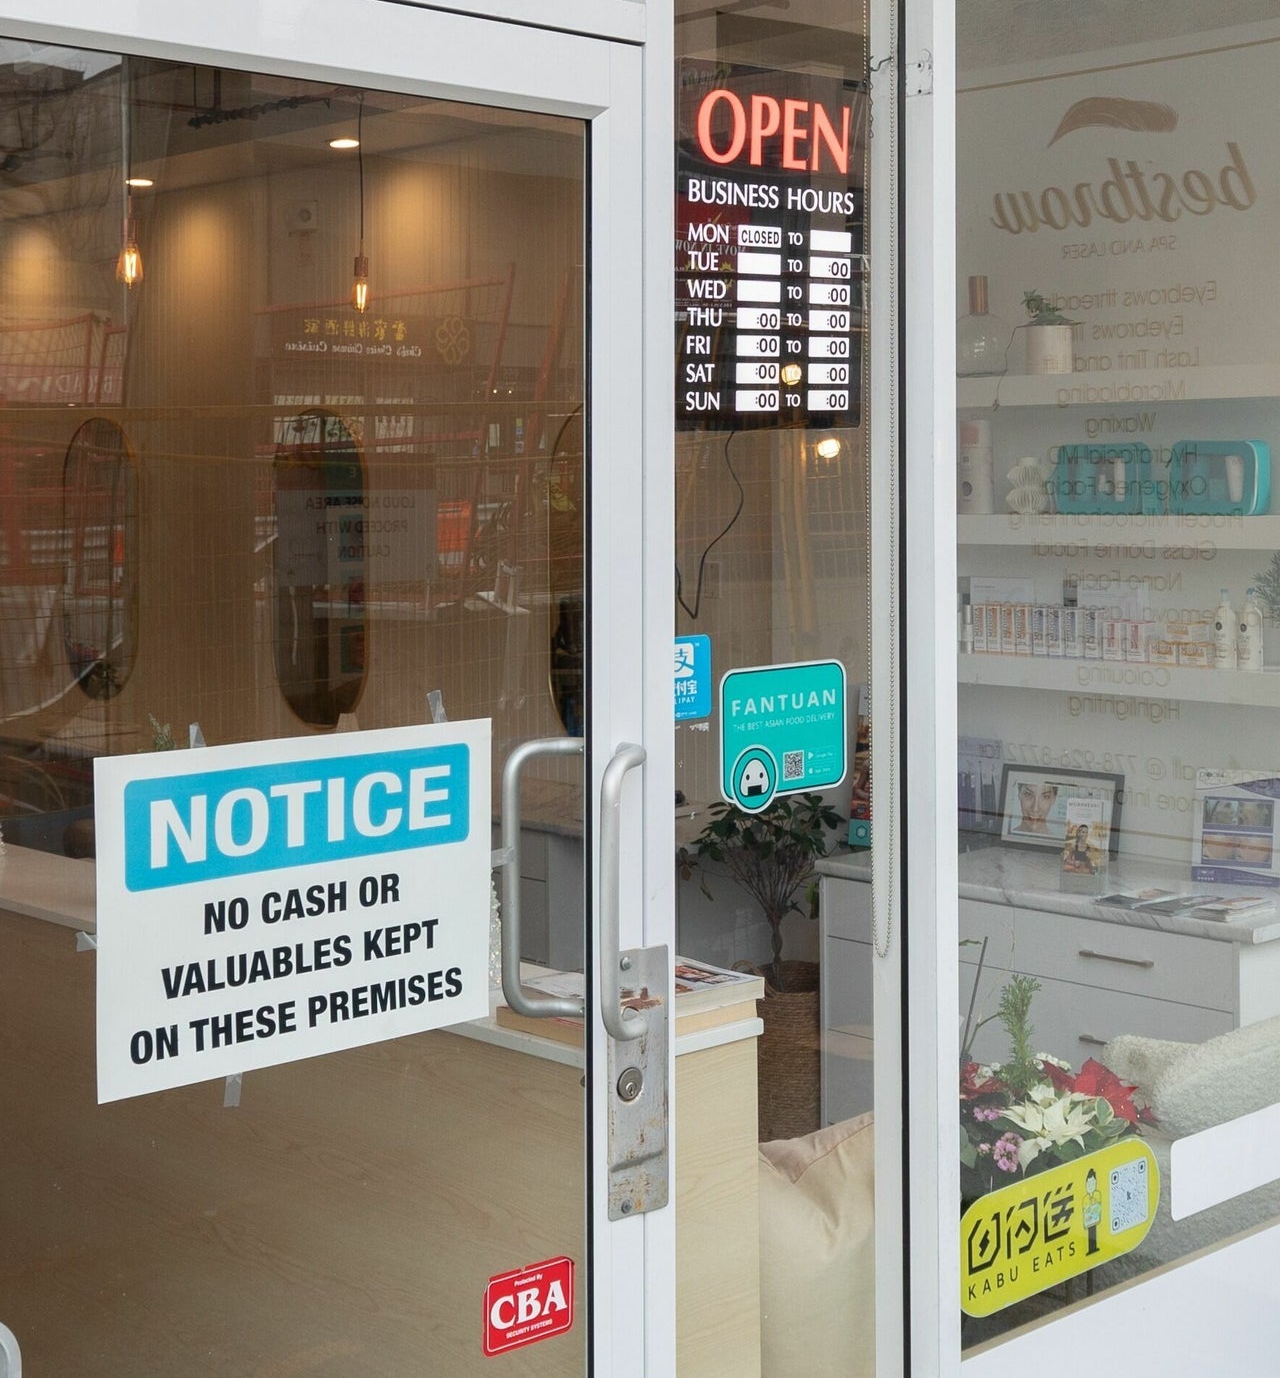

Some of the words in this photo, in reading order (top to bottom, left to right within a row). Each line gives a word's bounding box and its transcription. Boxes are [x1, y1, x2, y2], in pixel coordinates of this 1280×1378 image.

[696, 88, 851, 175] OPEN
[687, 178, 779, 209] BUSINESS
[787, 187, 855, 215] HOURS
[687, 222, 730, 245] MON
[741, 229, 780, 244] CLOSED
[788, 231, 804, 246] TO
[687, 251, 719, 271] TUE
[787, 259, 803, 273] TO
[687, 279, 726, 299] WED
[787, 286, 802, 300] TO
[686, 307, 722, 327] THU
[786, 313, 802, 327] TO
[686, 335, 711, 355] FRI
[786, 340, 802, 353] TO
[685, 363, 715, 383] SAT
[685, 391, 720, 411] SUN
[785, 394, 801, 407] TO
[675, 679, 698, 697] 付宝
[731, 688, 836, 717] FANTUAN
[149, 764, 452, 870] NOTICE
[203, 895, 249, 935] NO
[261, 880, 348, 925] CASH
[358, 872, 400, 908] OR
[161, 935, 352, 999] VALUABLES
[363, 918, 439, 962] KEPT
[130, 1022, 179, 1065] ON
[191, 998, 297, 1053] THESE
[308, 966, 463, 1028] PREMISES
[968, 1266, 1019, 1302] KABU
[1032, 1241, 1076, 1273] EATS
[490, 1279, 568, 1330] CBA
